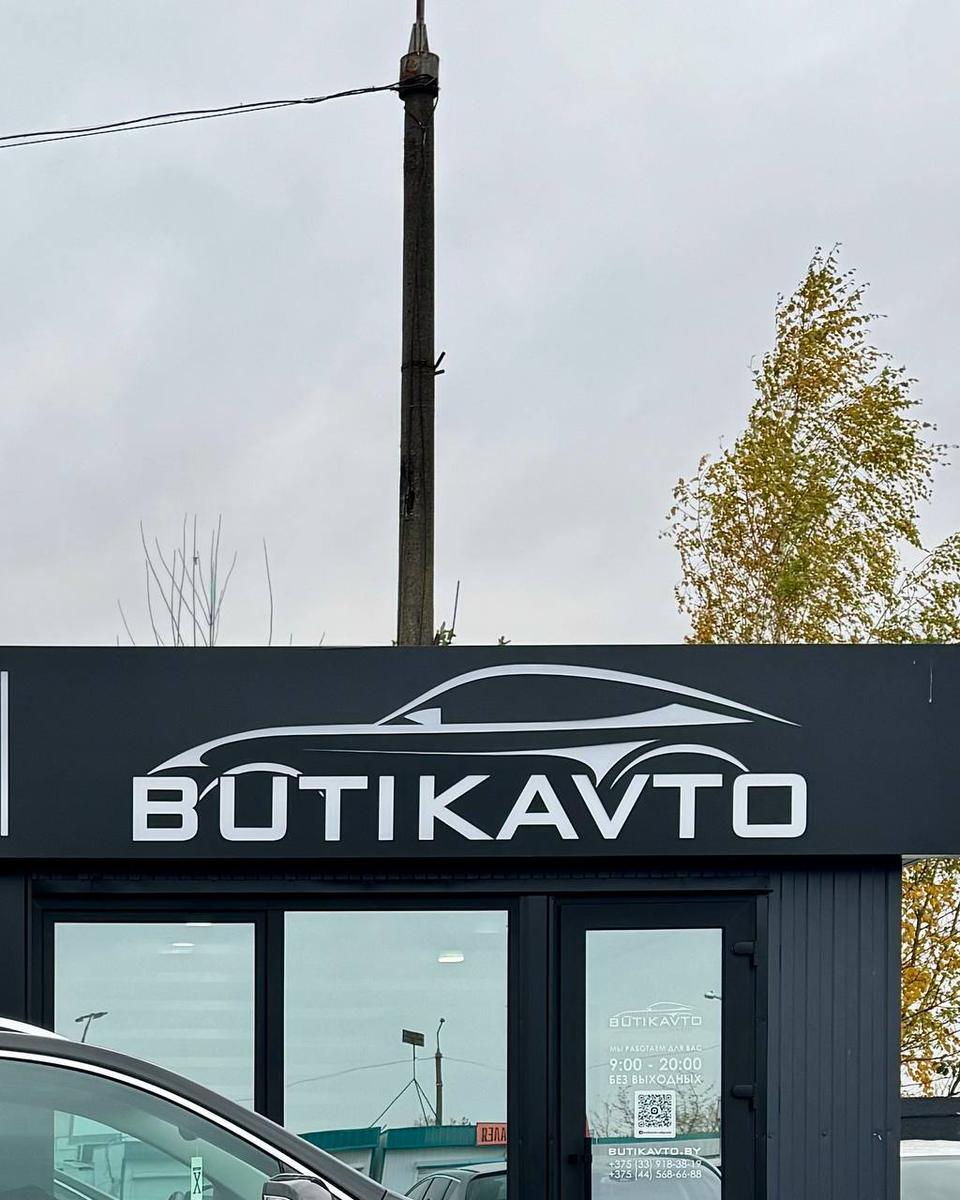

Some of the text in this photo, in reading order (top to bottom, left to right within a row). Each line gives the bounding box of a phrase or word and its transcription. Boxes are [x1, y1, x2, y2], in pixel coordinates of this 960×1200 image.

[132, 772, 808, 842] BUTIKAVTO
[609, 1016, 702, 1028] BUTIKAVTO
[609, 1058, 642, 1072] 9:00
[659, 1057, 702, 1071] 20:00
[609, 1074, 703, 1085] БЕЗ ВЫХОДНЫХ
[608, 1147, 701, 1156] BUTIKAVTO.BY
[609, 1159, 702, 1170] +375 (33) 918-38-19
[609, 1169, 702, 1181] +375 (44) 568-66-88
